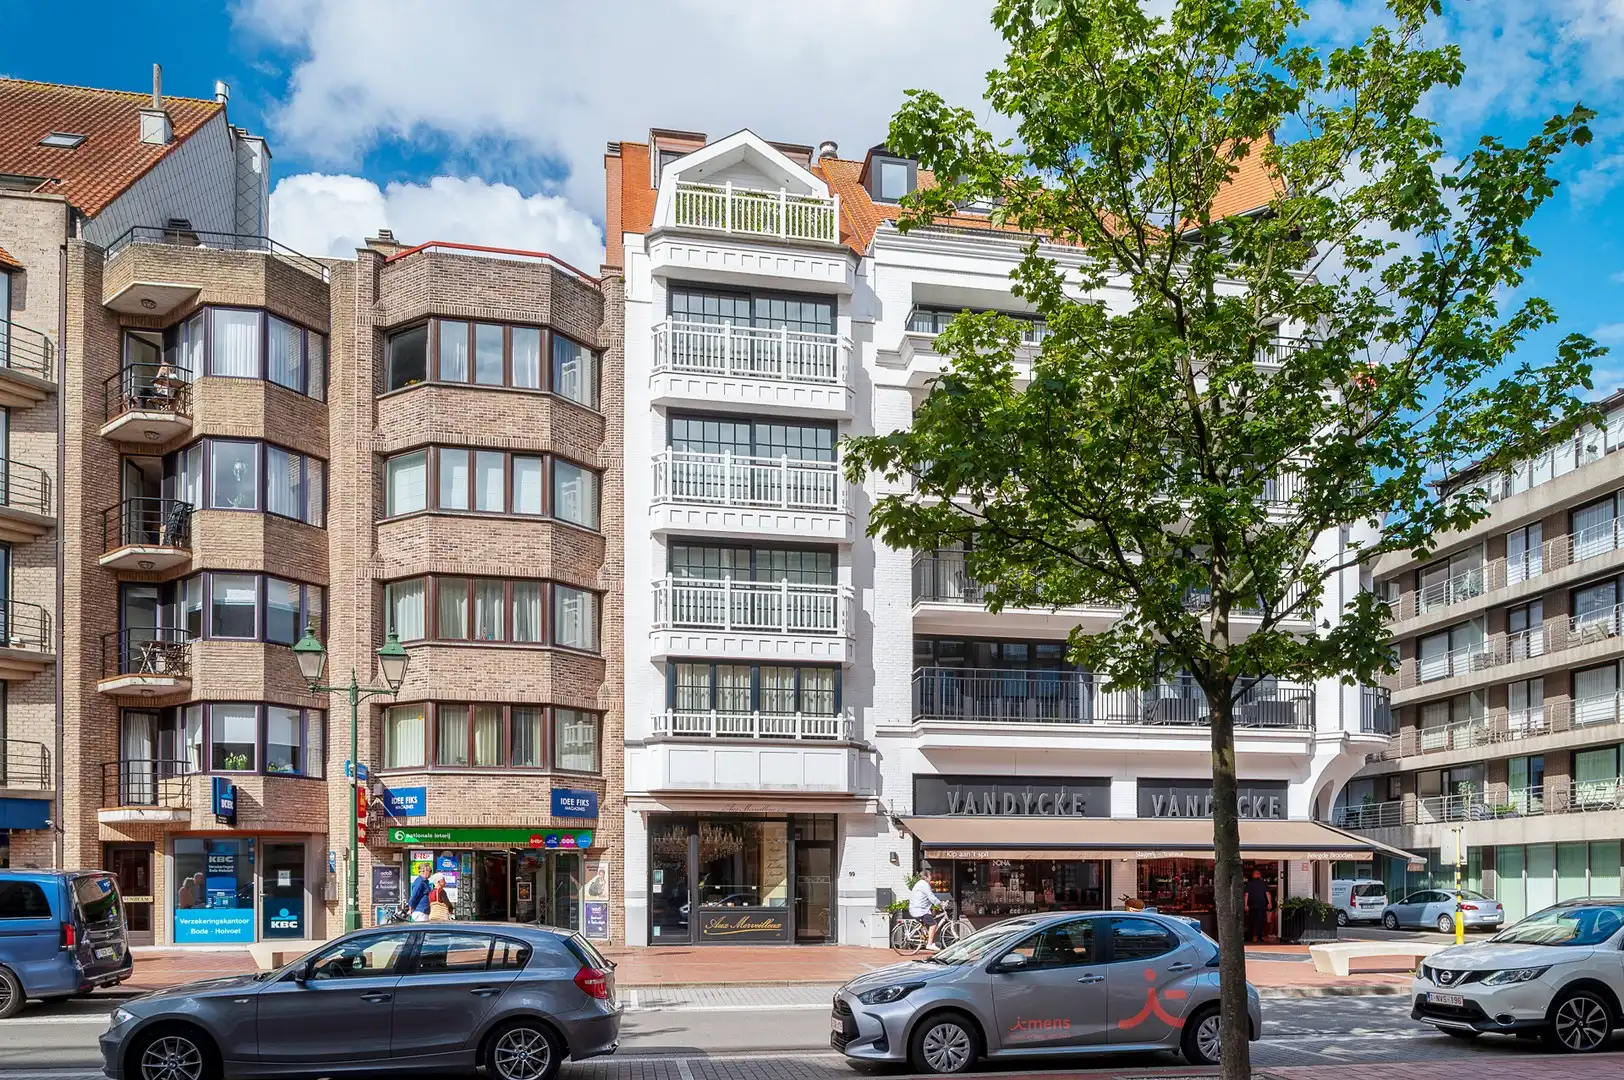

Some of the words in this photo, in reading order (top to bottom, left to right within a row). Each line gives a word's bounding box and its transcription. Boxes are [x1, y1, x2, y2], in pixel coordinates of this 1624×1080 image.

[391, 797, 404, 805] IDEE
[405, 795, 418, 804] FIKS
[560, 797, 575, 806] IDEE
[576, 798, 590, 807] FIKS
[947, 791, 1083, 816] VANDYCKE
[1152, 794, 1279, 818] VANDCKE
[179, 918, 249, 926] Verzekeringskantoor
[270, 921, 298, 929] KBC
[705, 915, 728, 930] Aux
[215, 927, 241, 935] Holvoet
